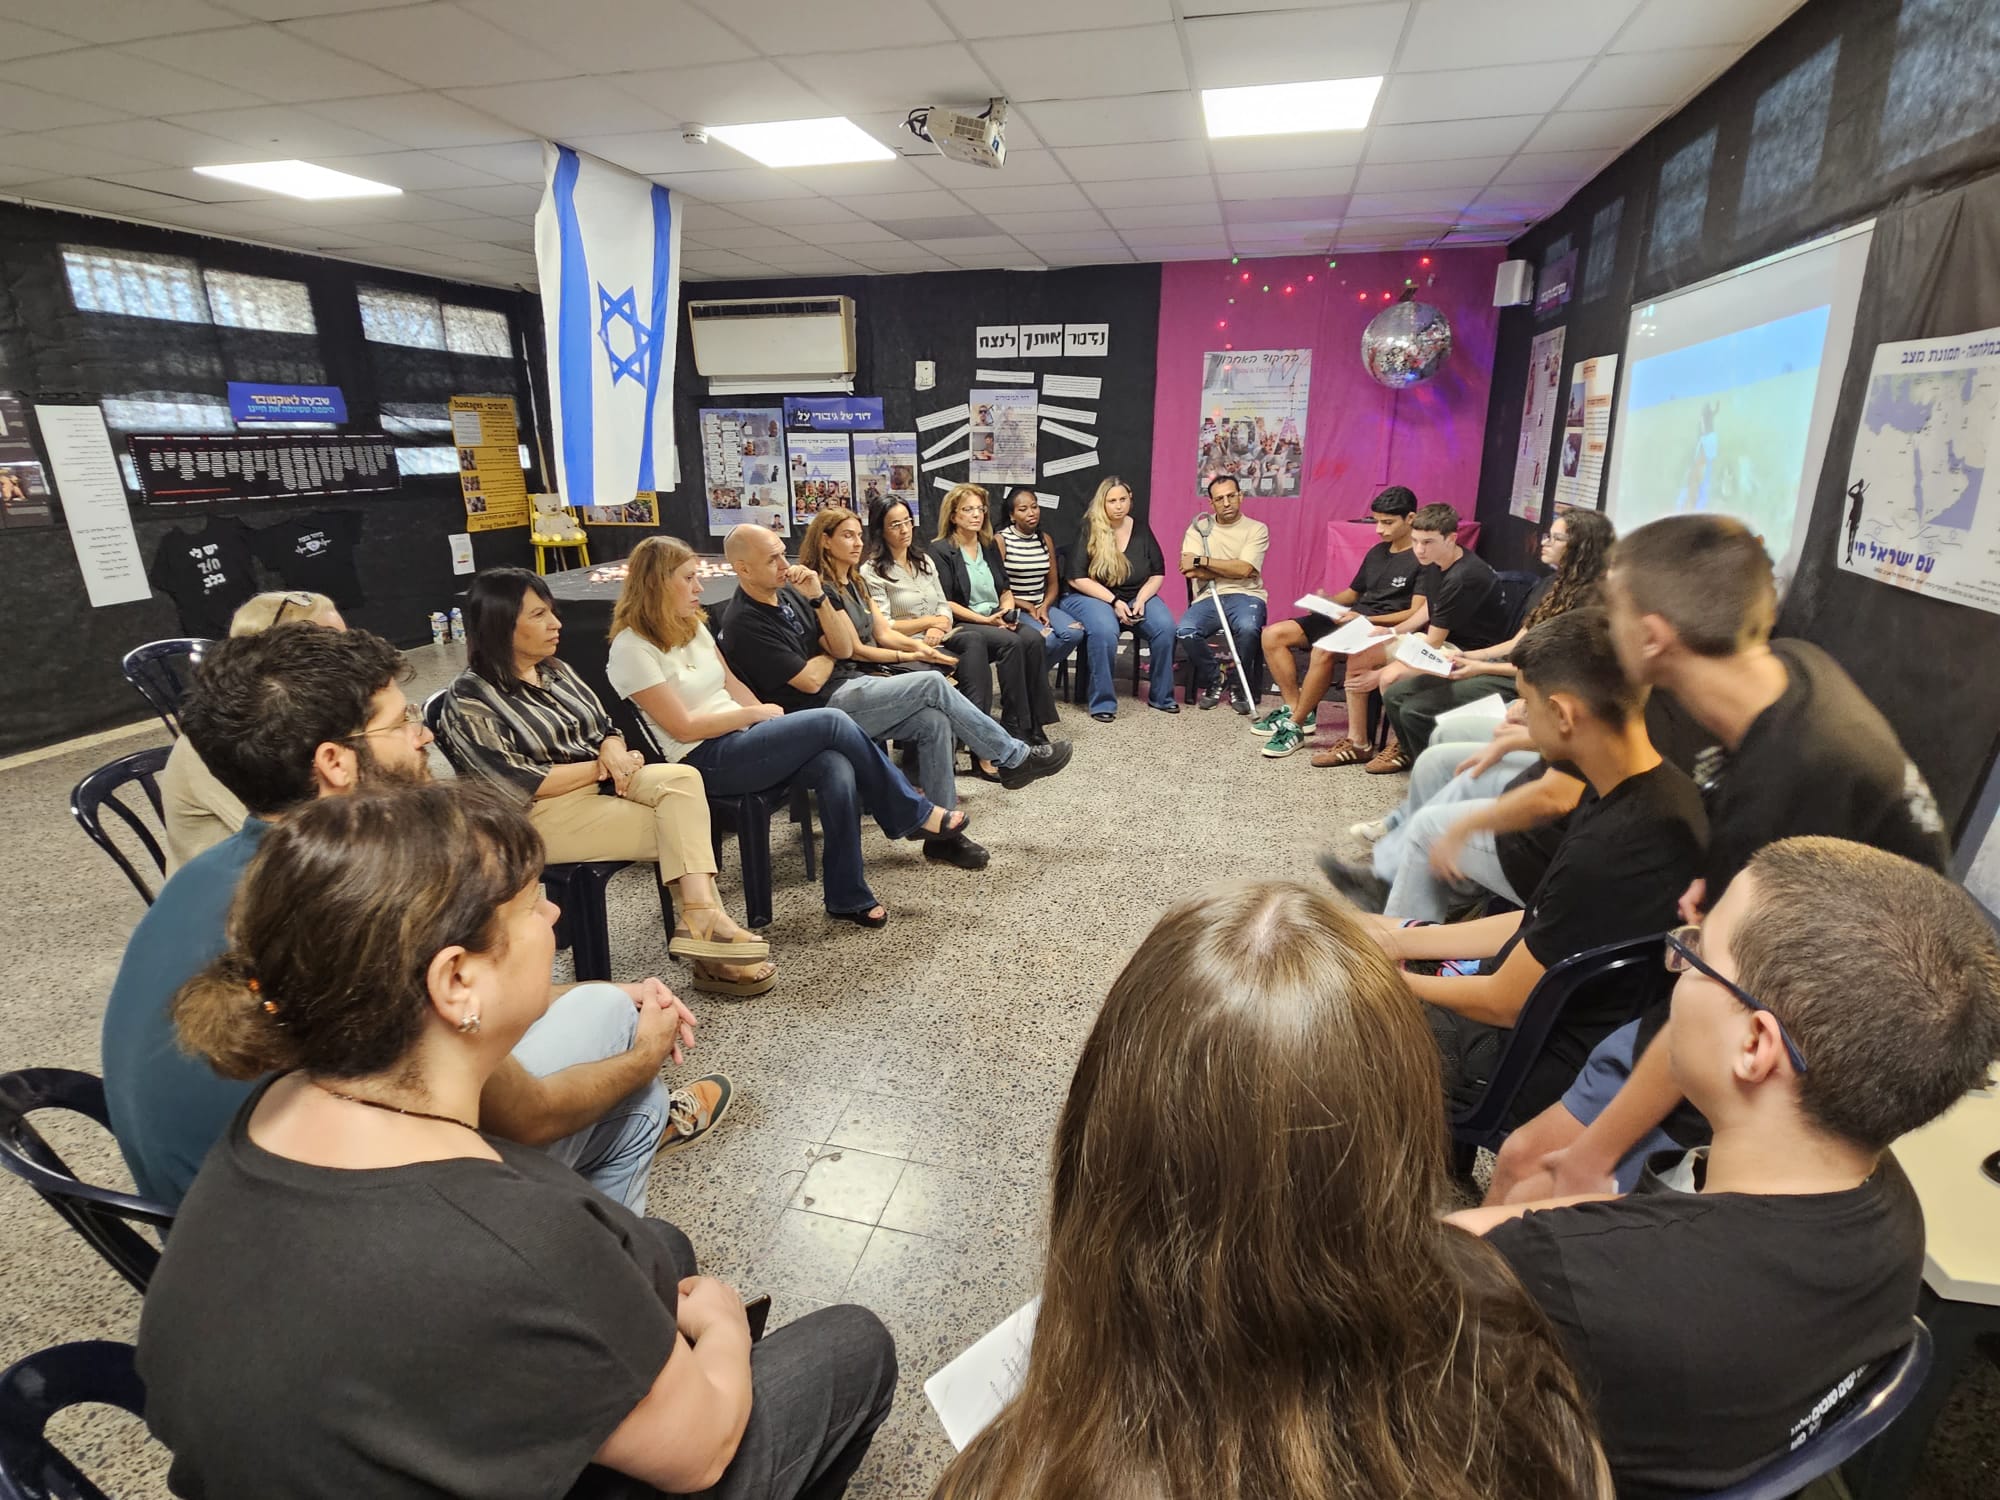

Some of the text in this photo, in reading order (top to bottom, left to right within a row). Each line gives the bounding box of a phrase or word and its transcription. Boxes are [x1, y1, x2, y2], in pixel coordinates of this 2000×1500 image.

[979, 332, 1016, 349] לנצח
[1023, 331, 1062, 352] אותך
[1216, 353, 1300, 368] הריקוד האחרון
[1901, 350, 1926, 364] מצב
[1927, 347, 1960, 362] תמונת
[250, 394, 330, 406] שבעה לאוקטובר
[268, 404, 281, 414] את
[797, 410, 872, 421] דור של גיבורי על
[1854, 541, 1867, 557] חי
[1869, 540, 1914, 567] ישראל
[1915, 553, 1936, 574] עם
[202, 573, 227, 588] בלב
